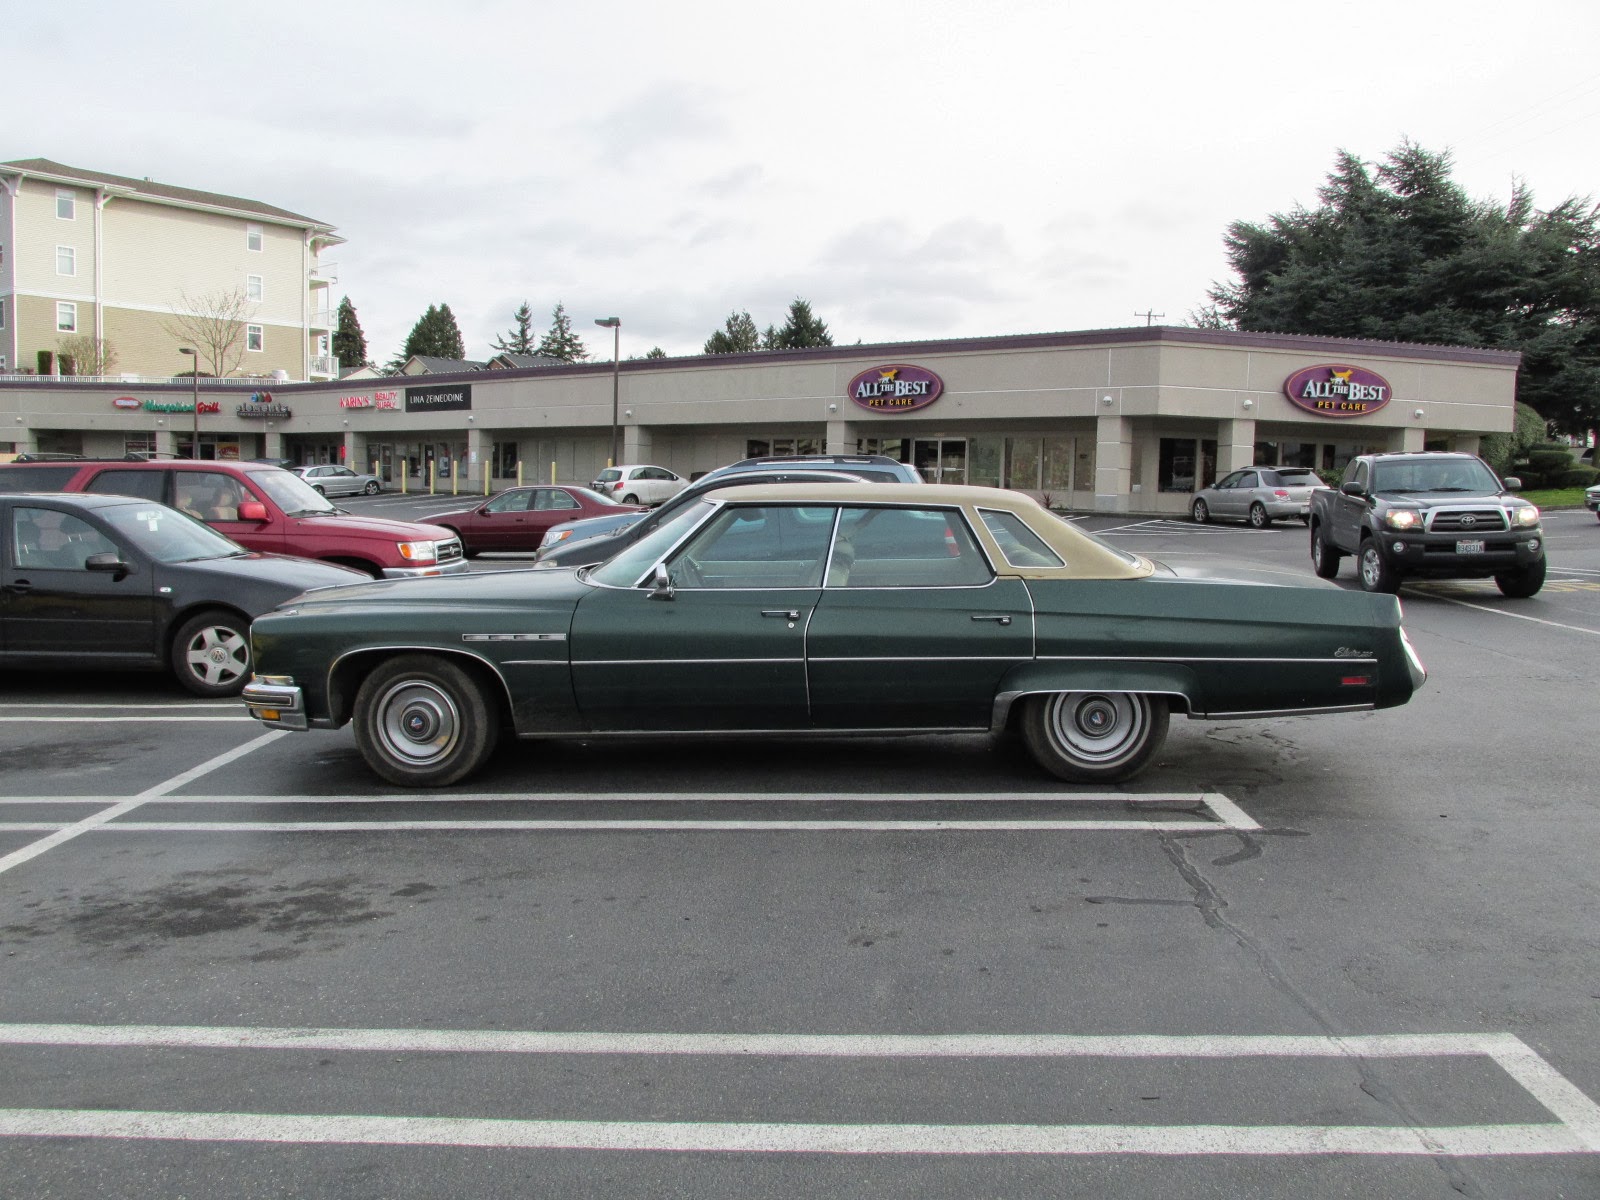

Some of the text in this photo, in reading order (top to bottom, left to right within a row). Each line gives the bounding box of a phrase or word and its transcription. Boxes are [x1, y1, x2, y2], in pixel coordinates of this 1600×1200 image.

[856, 381, 929, 397] ALL THE BEST
[1303, 380, 1386, 400] ALL THE BEST
[374, 392, 398, 401] BEAUTY
[410, 395, 425, 404] LINA
[340, 396, 371, 408] KARIN'S
[375, 401, 396, 410] SUPPLY
[869, 398, 913, 407] PET CARE
[1317, 401, 1367, 411] PET CARE
[197, 401, 221, 414] Grill
